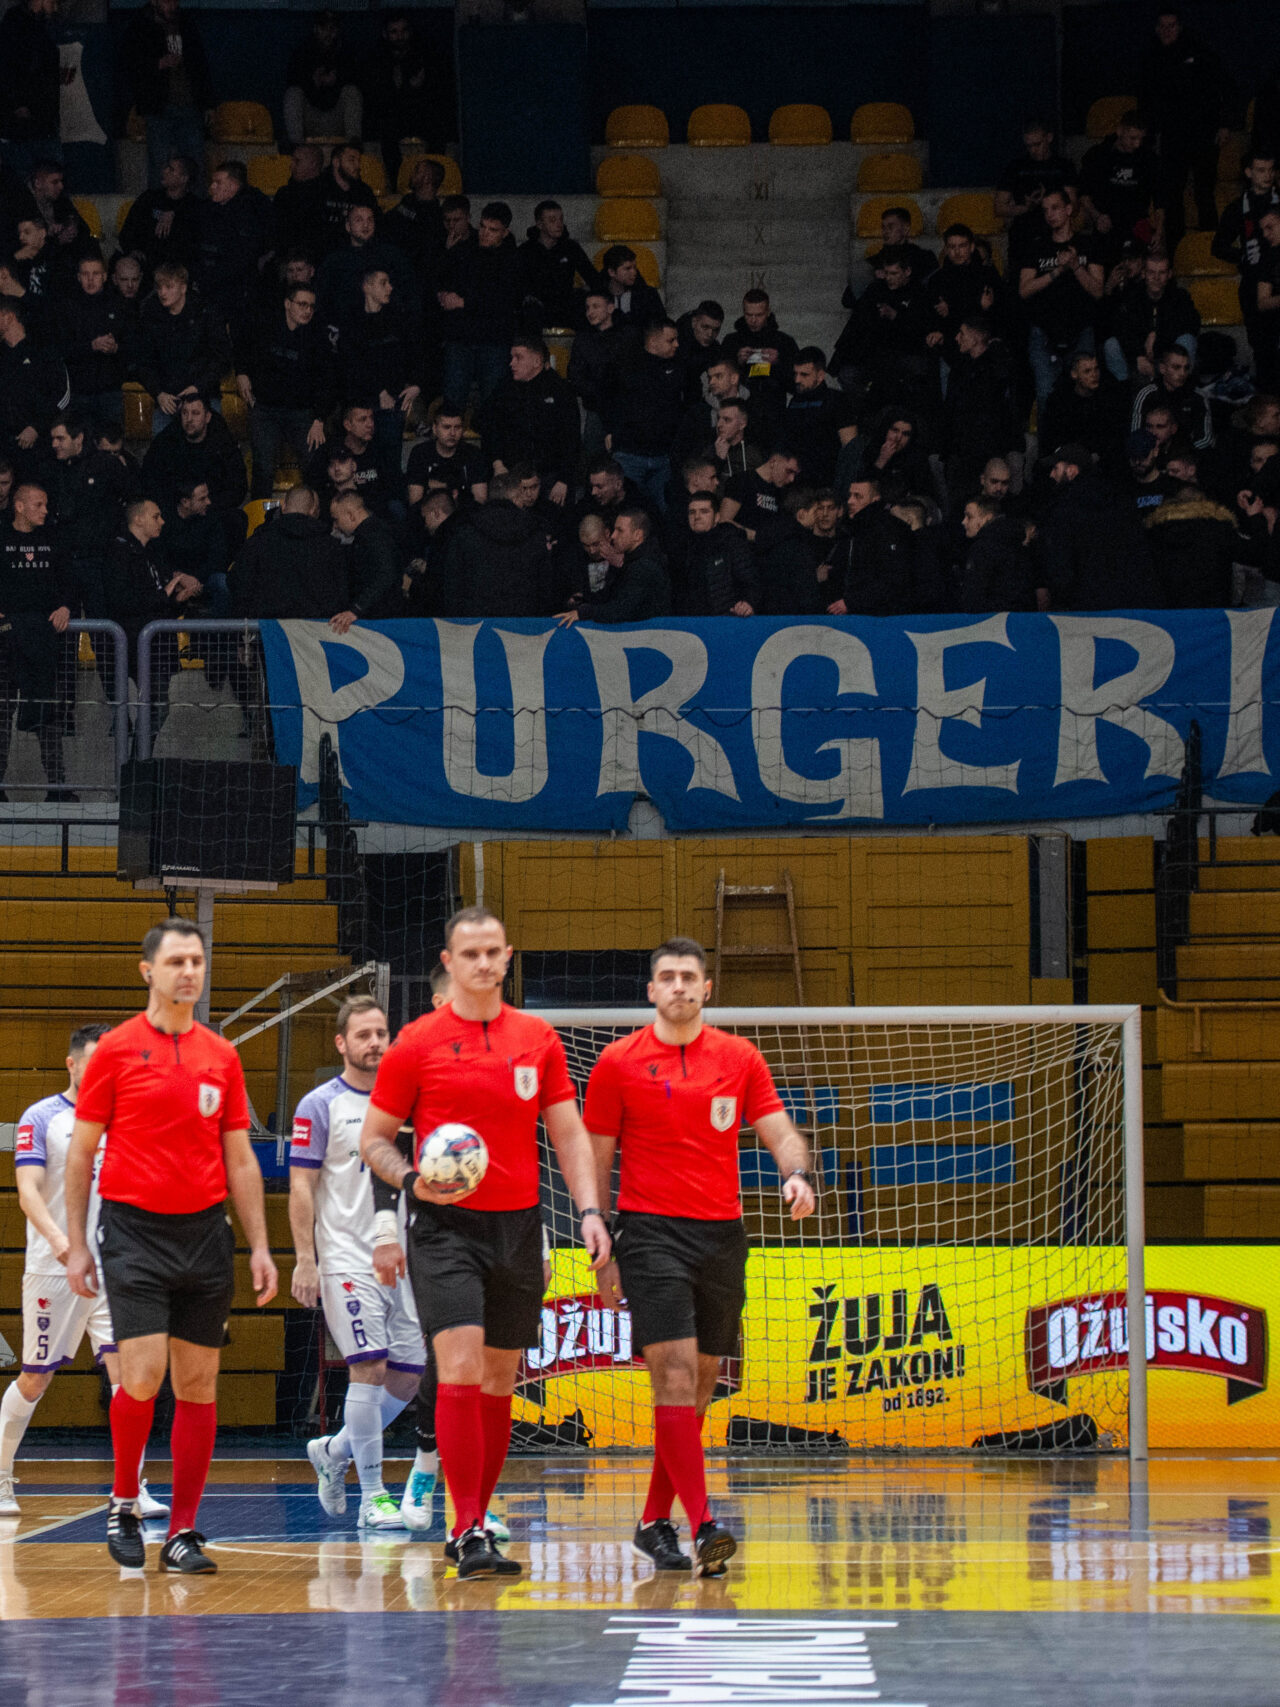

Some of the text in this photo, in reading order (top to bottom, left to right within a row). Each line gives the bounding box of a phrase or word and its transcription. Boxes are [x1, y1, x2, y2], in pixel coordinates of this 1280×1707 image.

[278, 607, 1280, 820] PURGERI
[351, 1319, 368, 1348] 6
[809, 1283, 953, 1362] ŽUJA
[37, 1334, 49, 1361] 5
[804, 1344, 965, 1403] JE ZAKON!
[883, 1386, 951, 1413] od 1892.
